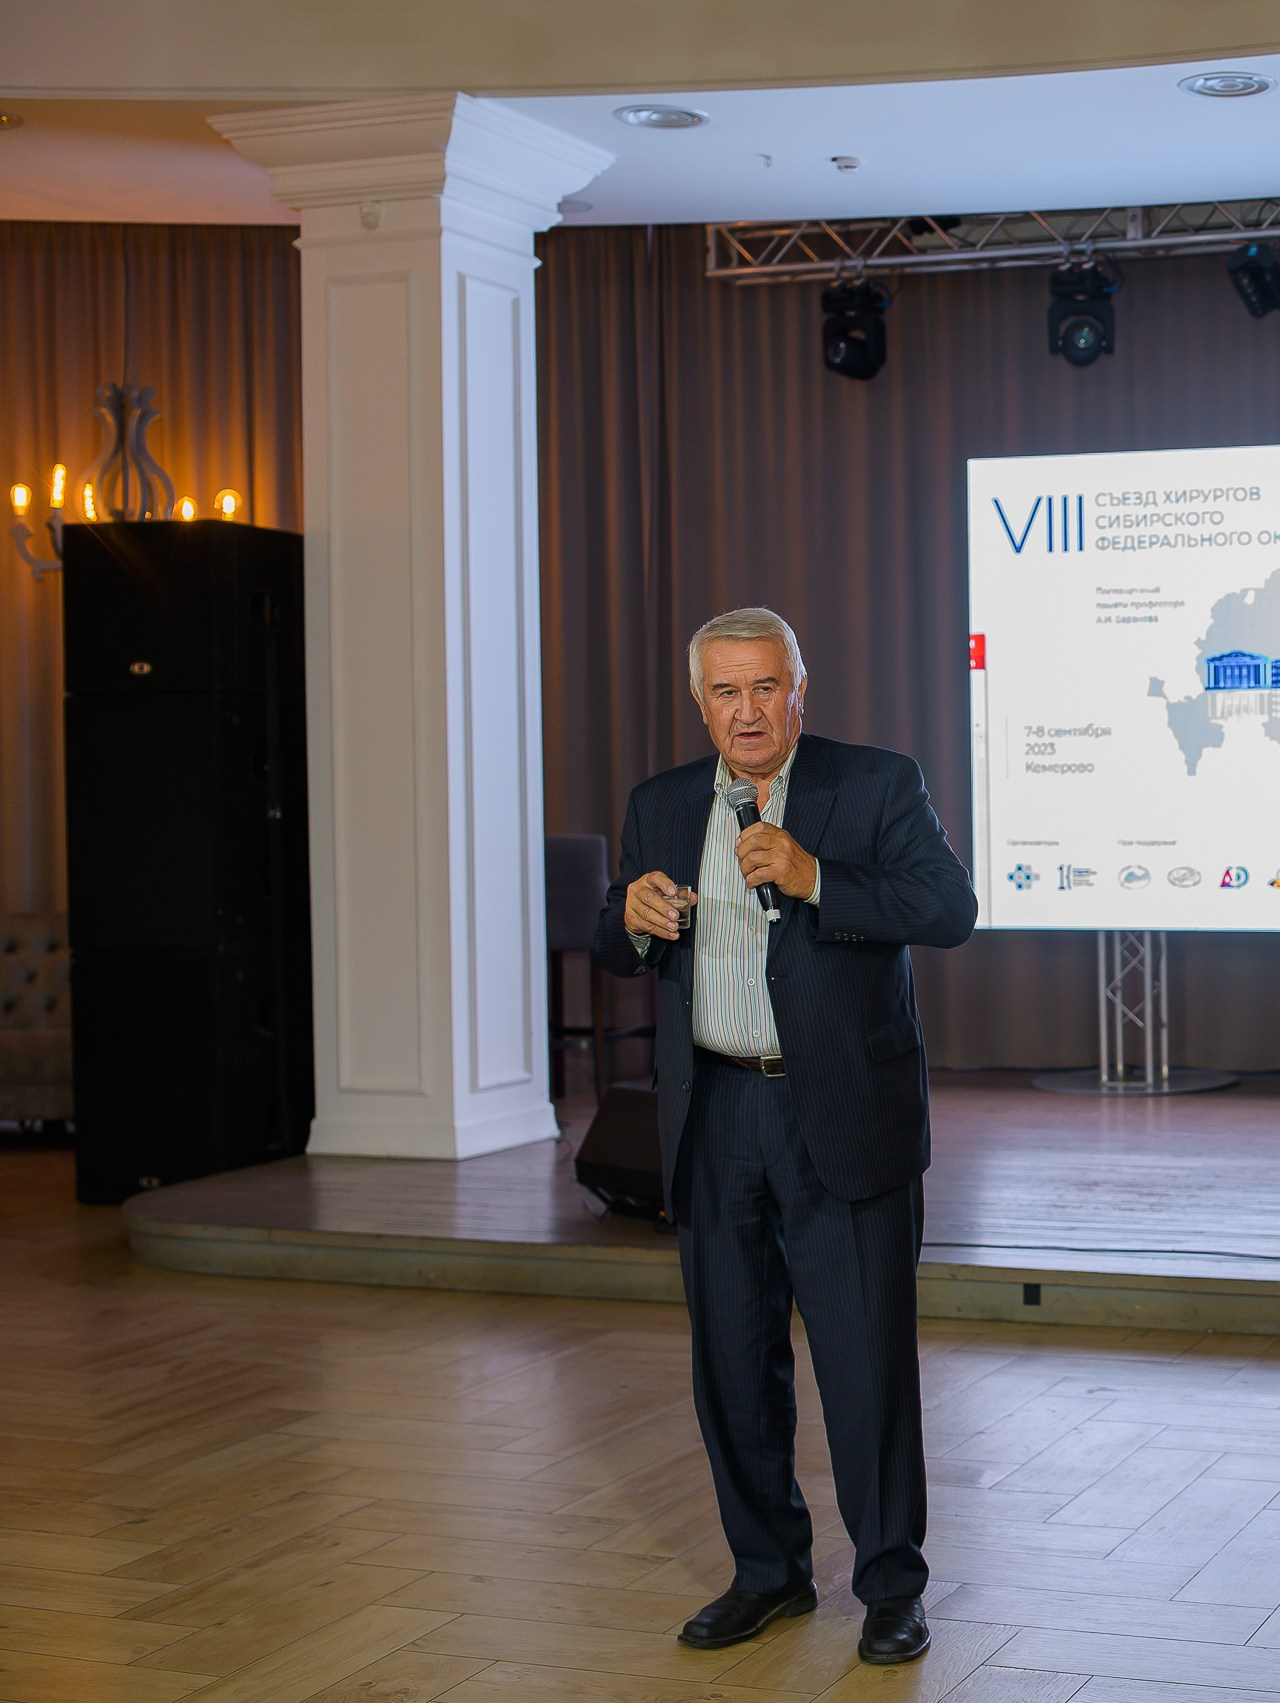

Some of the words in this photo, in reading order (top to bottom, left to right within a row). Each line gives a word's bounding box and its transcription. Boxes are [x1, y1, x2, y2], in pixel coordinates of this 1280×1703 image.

[1094, 491, 1159, 508] СЪЕЗД
[1162, 486, 1261, 505] ХИРУРГОВ
[991, 494, 1085, 555] VIII
[1094, 510, 1225, 530] СИБИРСКОГО
[1094, 530, 1252, 552] ФЕДЕРАЛЬНОГО
[1024, 742, 1056, 756] 2023
[1024, 761, 1095, 775] Кемерово
